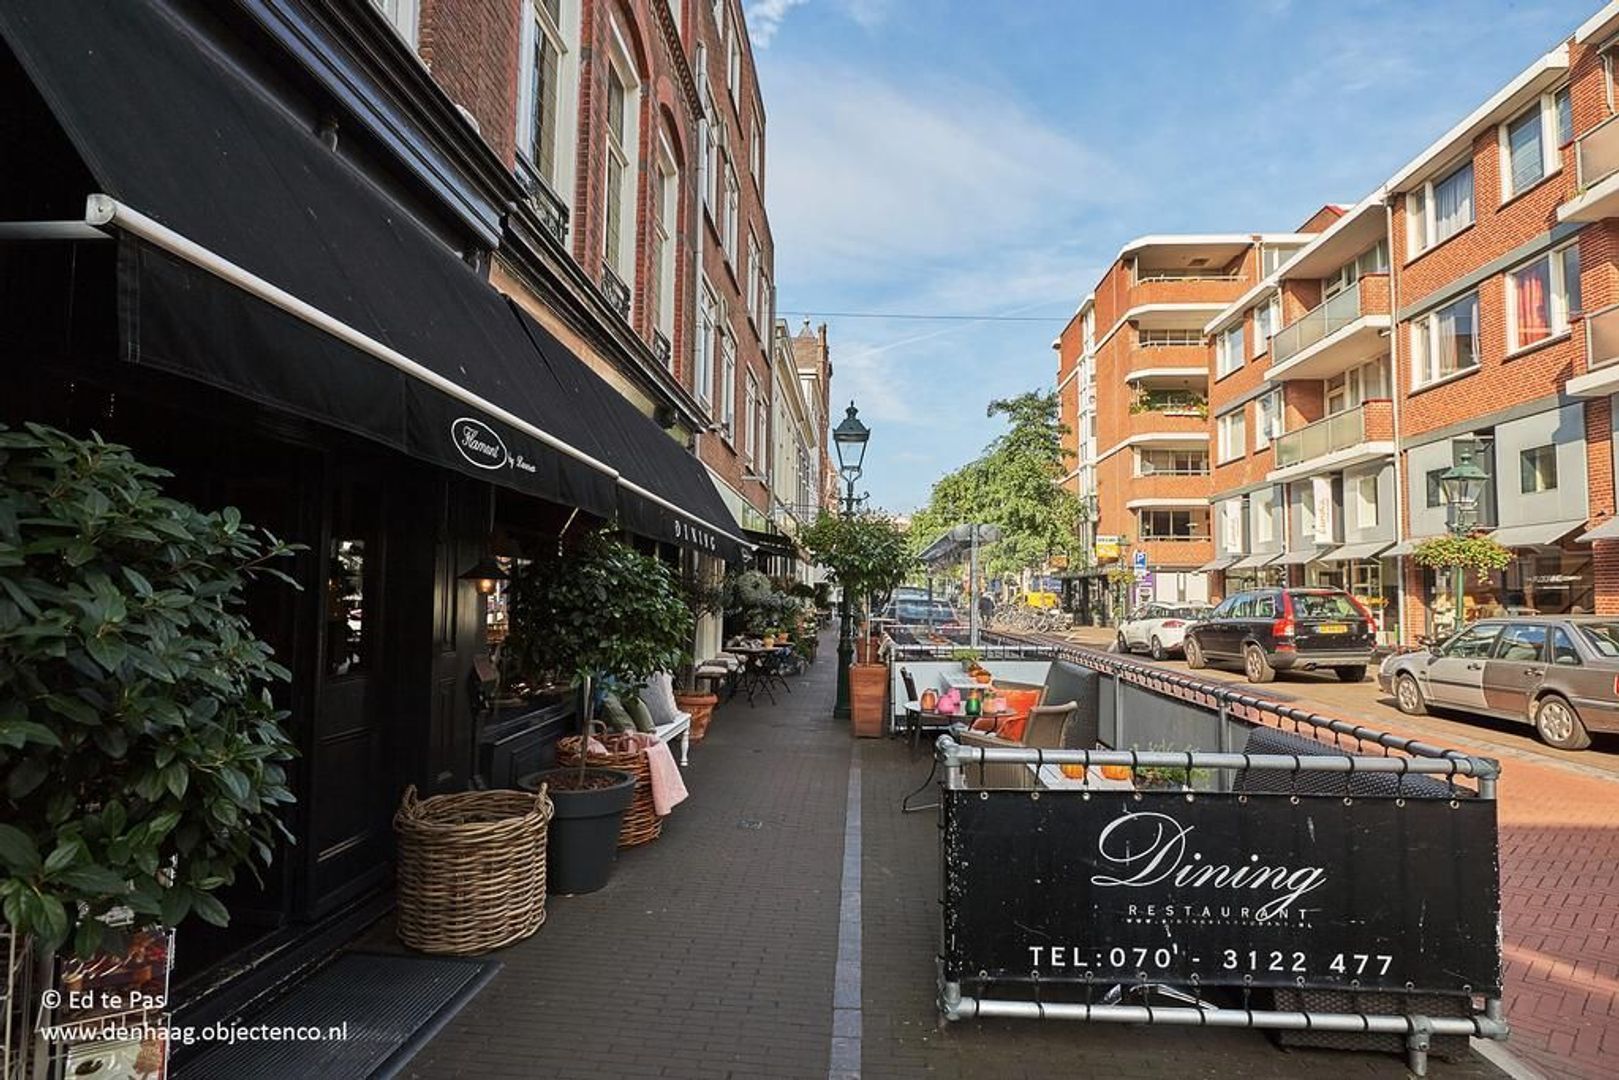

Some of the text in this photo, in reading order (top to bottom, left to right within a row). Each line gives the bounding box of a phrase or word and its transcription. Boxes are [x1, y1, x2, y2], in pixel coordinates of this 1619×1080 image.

[674, 519, 716, 551] DINING
[1137, 554, 1144, 563] P
[1090, 811, 1326, 921] Dining
[1128, 904, 1307, 920] RESTAURANT
[1028, 946, 1171, 968] TEL:070
[1223, 949, 1307, 972] 3122
[1330, 953, 1393, 976] 477
